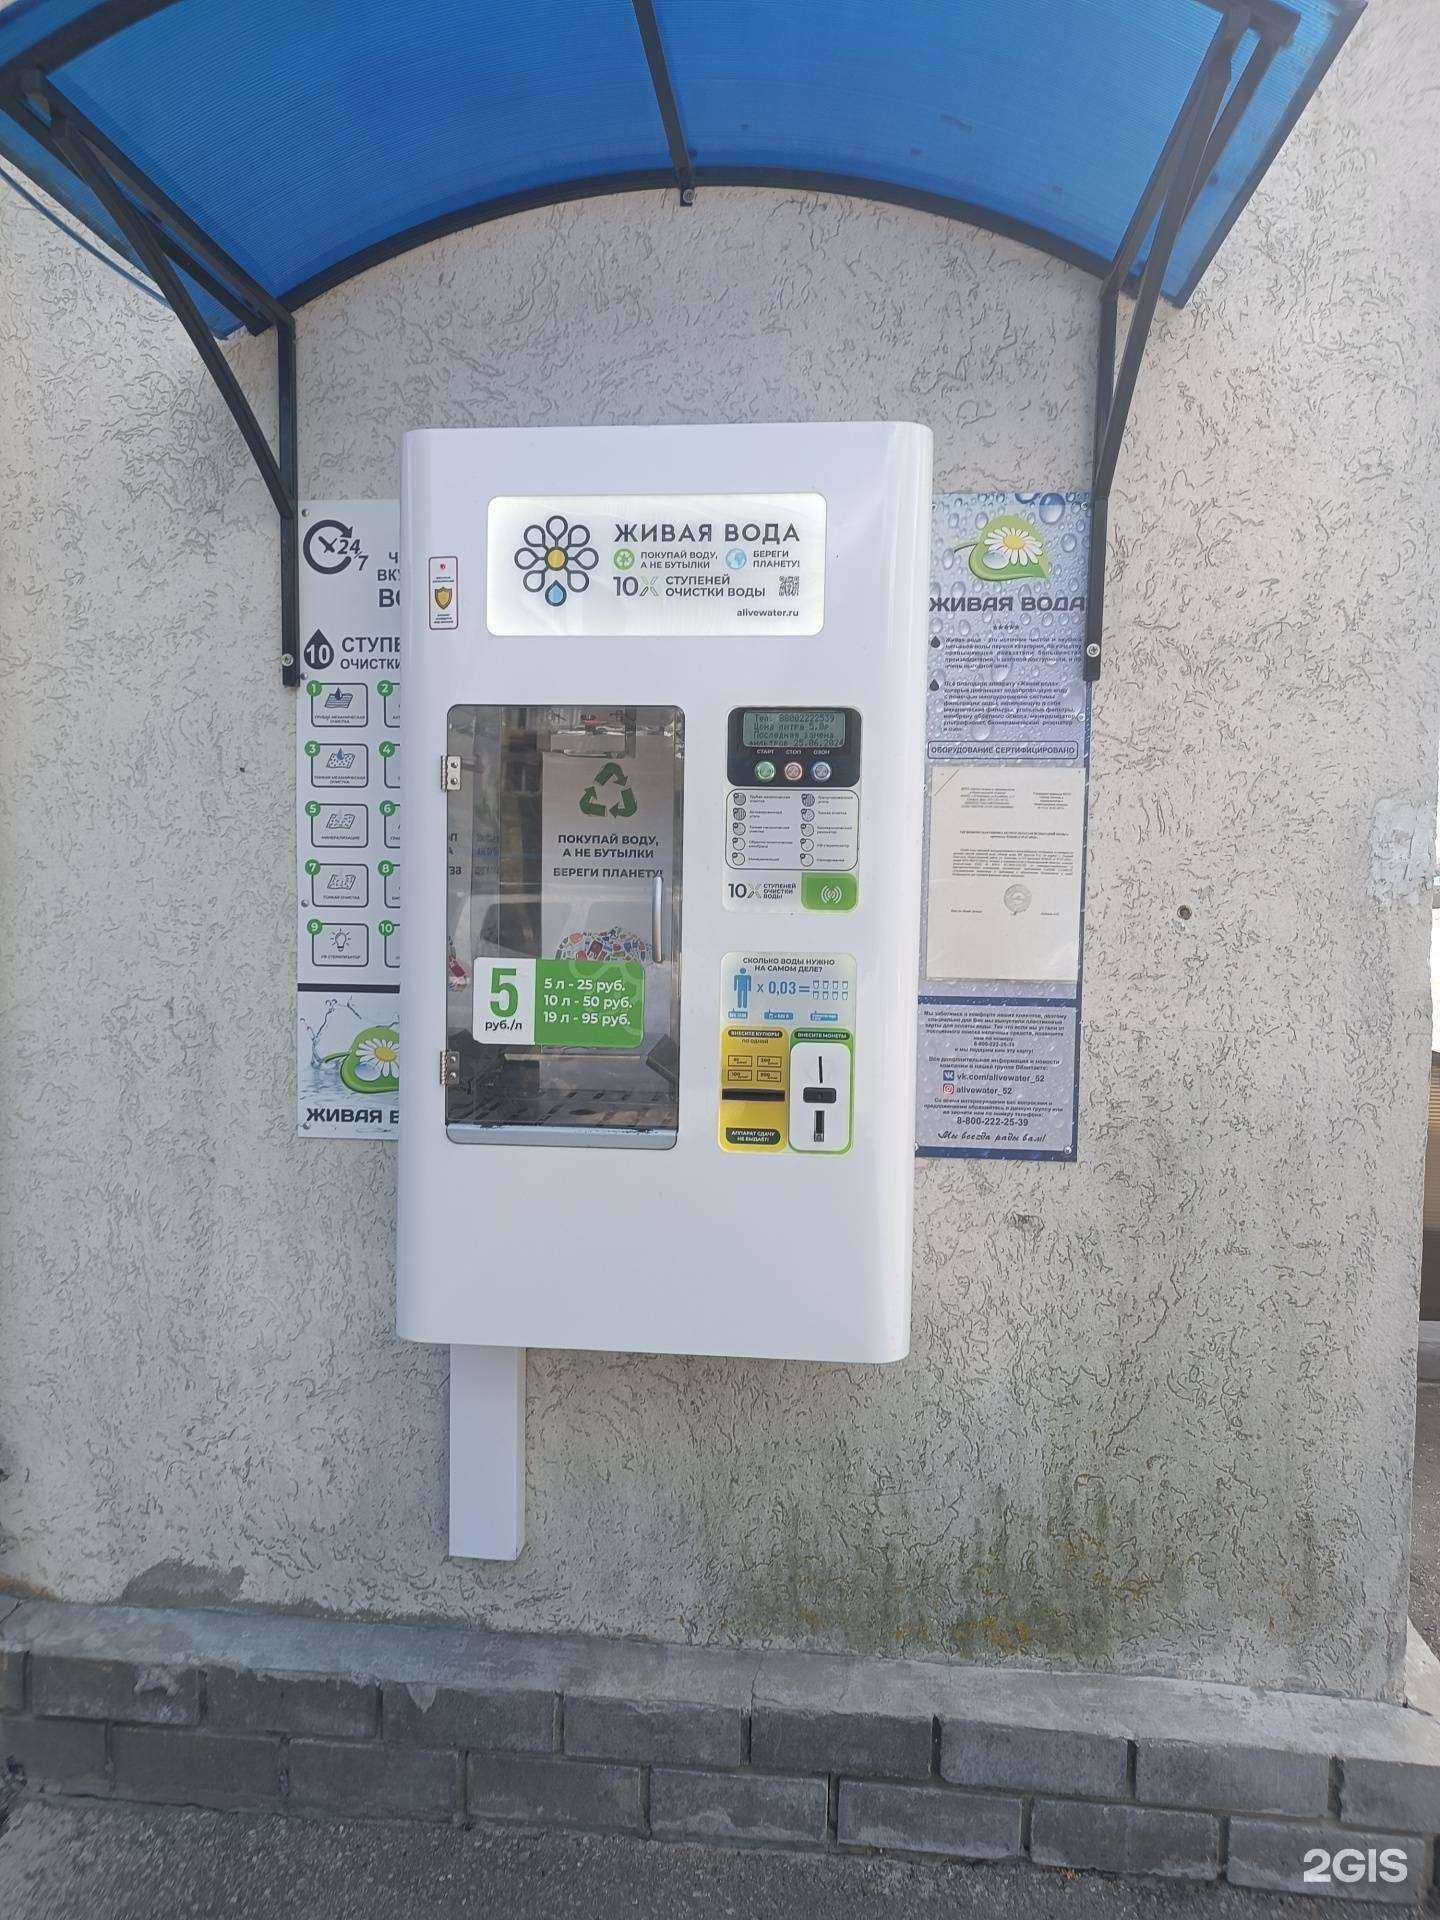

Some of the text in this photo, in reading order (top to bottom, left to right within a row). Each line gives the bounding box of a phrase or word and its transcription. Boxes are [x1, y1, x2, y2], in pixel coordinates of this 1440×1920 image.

[614, 523, 800, 545] ЖИВАЯ ВОДА
[640, 550, 718, 561] ПОКУПАЙ ВОДУ,
[753, 550, 800, 568] БЕРЕГИ ПЛАНЕТУ!
[664, 561, 710, 569] БУТЫЛКИ
[665, 574, 730, 585] СТУПЕНЕЙ
[665, 587, 766, 599] ОЧИСТКИ ВОДЫ
[929, 597, 1086, 612] ЖИВАЯ ВОДА
[736, 608, 799, 617] alivewater.ru
[306, 644, 331, 664] 10
[931, 746, 1076, 755] ОБОРУДОВАНИЕ СЕРТИФИЦИРОВАНО
[558, 834, 659, 846] ПОКУПАЙ ВОДУ,
[563, 849, 654, 858] А НЕ БУТЫЛКИ
[553, 868, 599, 877] БЕРЕГИ
[380, 924, 393, 932] 10
[743, 957, 779, 965] СКОЛЬКО
[781, 958, 804, 966] ВОДЫ
[768, 965, 797, 973] САМОМ
[798, 966, 823, 974] ДЕЛЕ?
[544, 978, 552, 988] 5
[556, 981, 565, 989] л
[577, 980, 593, 989] 25
[596, 980, 626, 993] руб.
[768, 981, 796, 996] 0,03
[490, 968, 518, 1017] 5
[544, 995, 559, 1006] 10
[562, 998, 571, 1006] л
[583, 997, 600, 1006] 50
[603, 997, 632, 1010] руб.
[543, 1012, 557, 1023] 19
[560, 1015, 570, 1023] л
[582, 1014, 599, 1024] 95
[602, 1014, 631, 1027] руб.
[485, 1020, 523, 1031] руб./л
[307, 1108, 382, 1123] ЖИВАЯ
[957, 1116, 1029, 1126] 8-800-222-25-39
